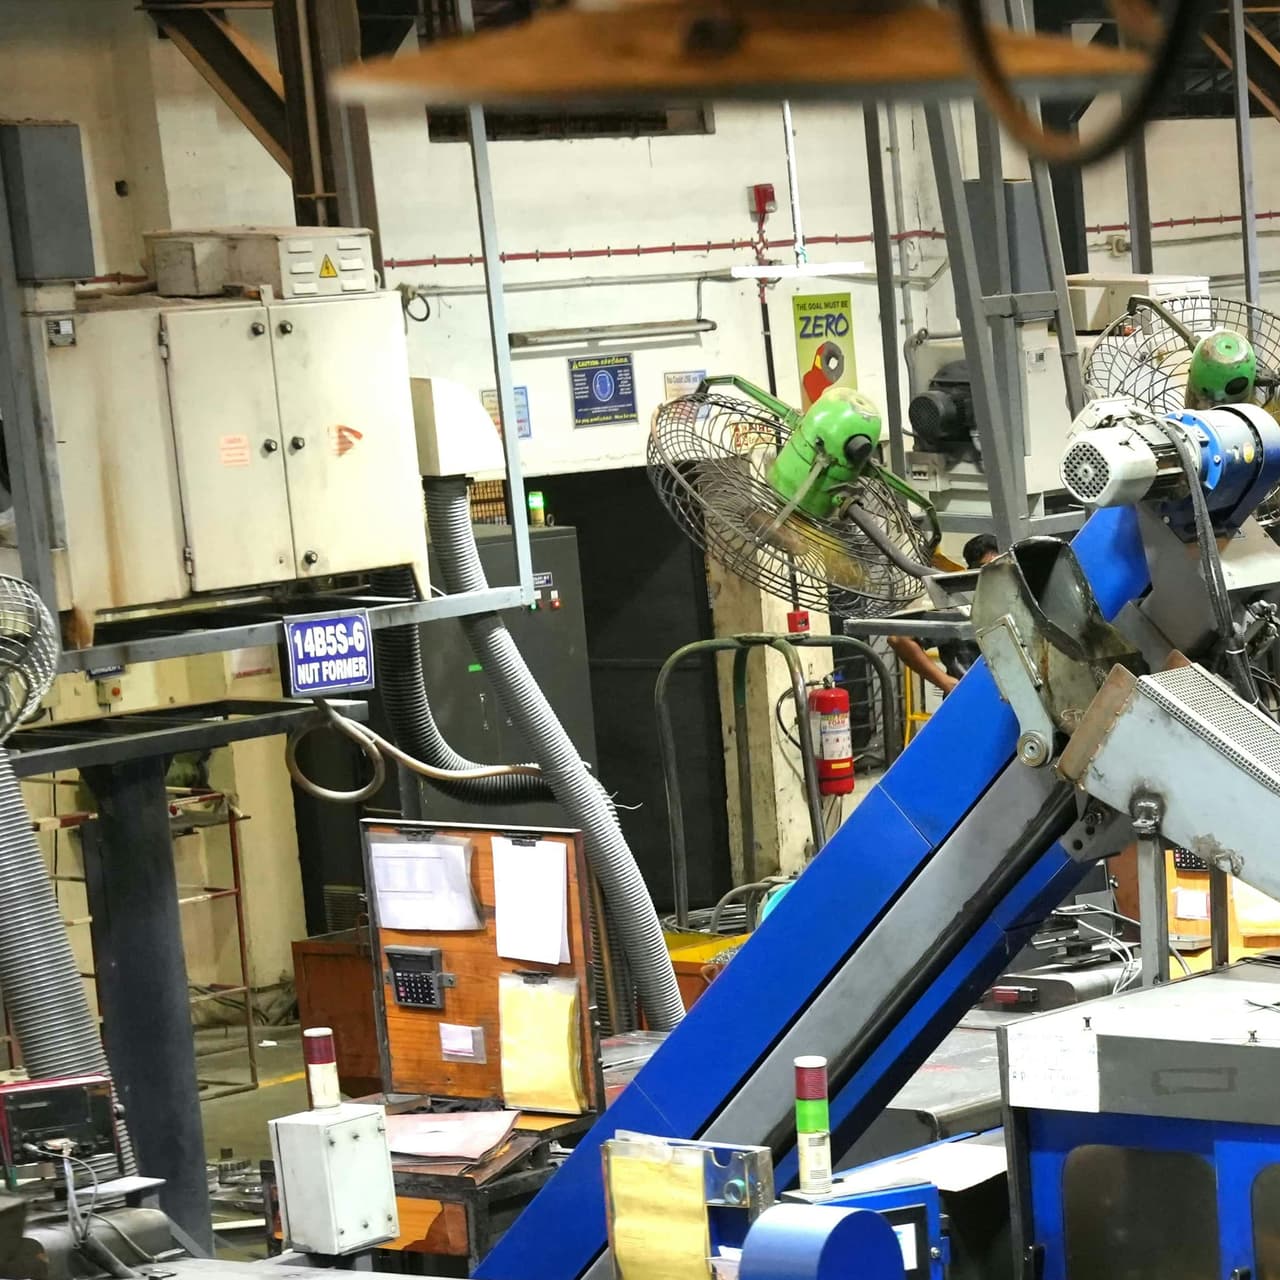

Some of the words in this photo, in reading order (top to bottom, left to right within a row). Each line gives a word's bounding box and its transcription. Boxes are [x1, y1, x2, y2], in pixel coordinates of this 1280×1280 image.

[796, 303, 807, 311] THE
[808, 302, 823, 310] GOAL
[824, 301, 840, 309] MUST
[840, 300, 849, 308] BE
[799, 313, 849, 338] ZERO
[294, 622, 365, 659] 14B5S-6
[297, 663, 320, 685] NUT
[321, 657, 367, 682] FORMER
